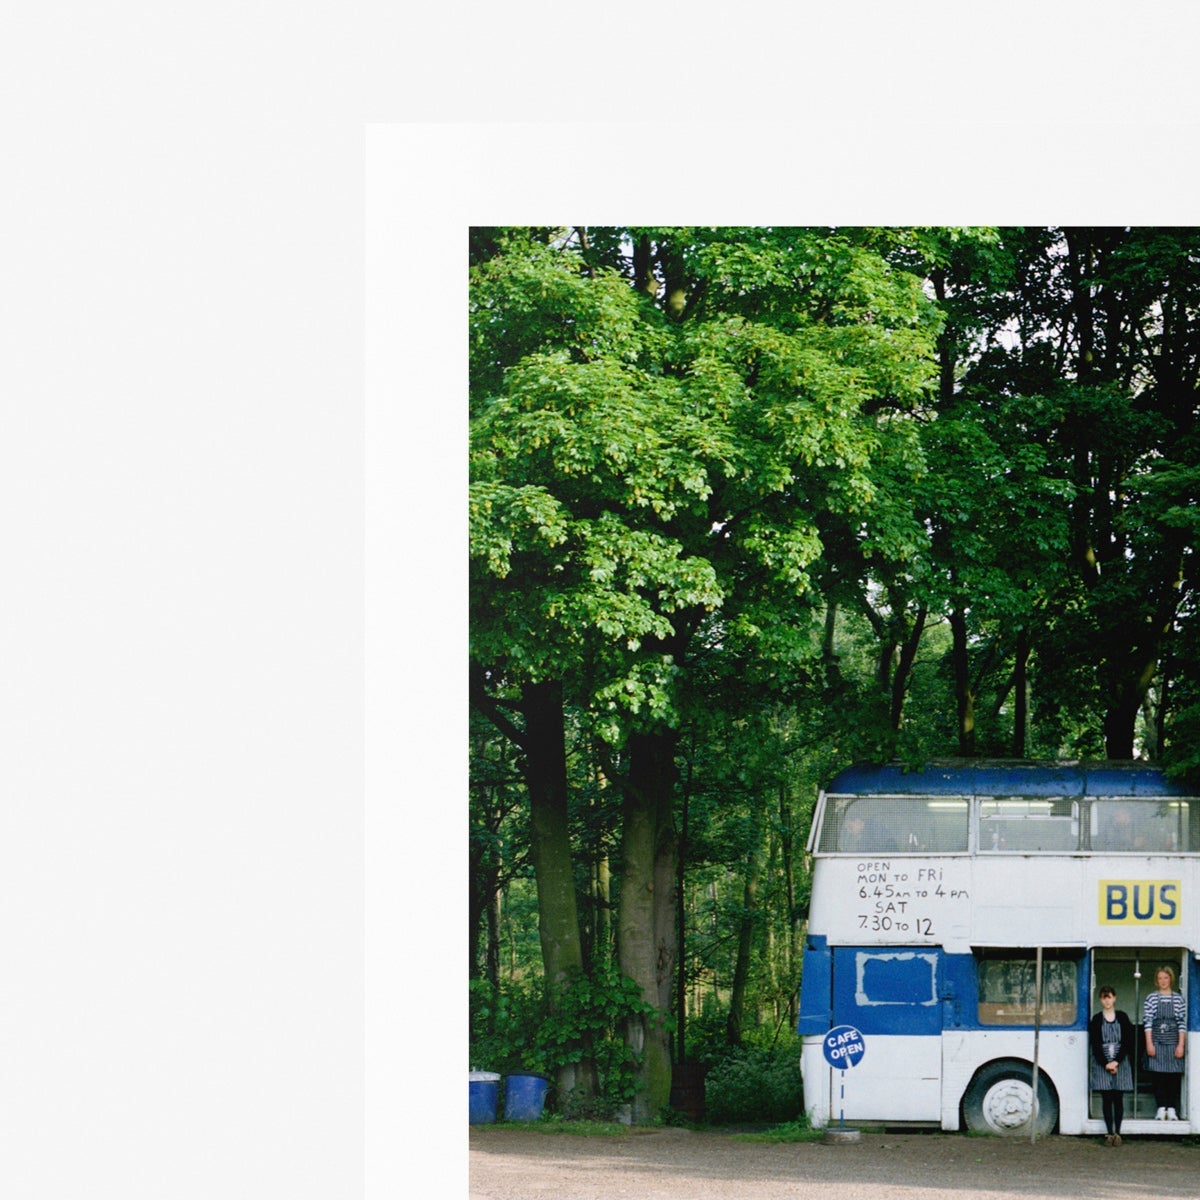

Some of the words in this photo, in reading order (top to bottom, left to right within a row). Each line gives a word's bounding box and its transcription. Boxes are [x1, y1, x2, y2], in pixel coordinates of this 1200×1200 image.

[857, 862, 890, 872] OPEN
[857, 873, 887, 883] MON
[916, 890, 928, 898] TO
[875, 901, 907, 914] SAT
[1106, 884, 1177, 920] BUS
[858, 915, 892, 931] 7.30
[895, 923, 909, 931] TO
[916, 918, 935, 936] 12
[828, 1030, 858, 1047] CAFE
[831, 1042, 863, 1059] OPEN
